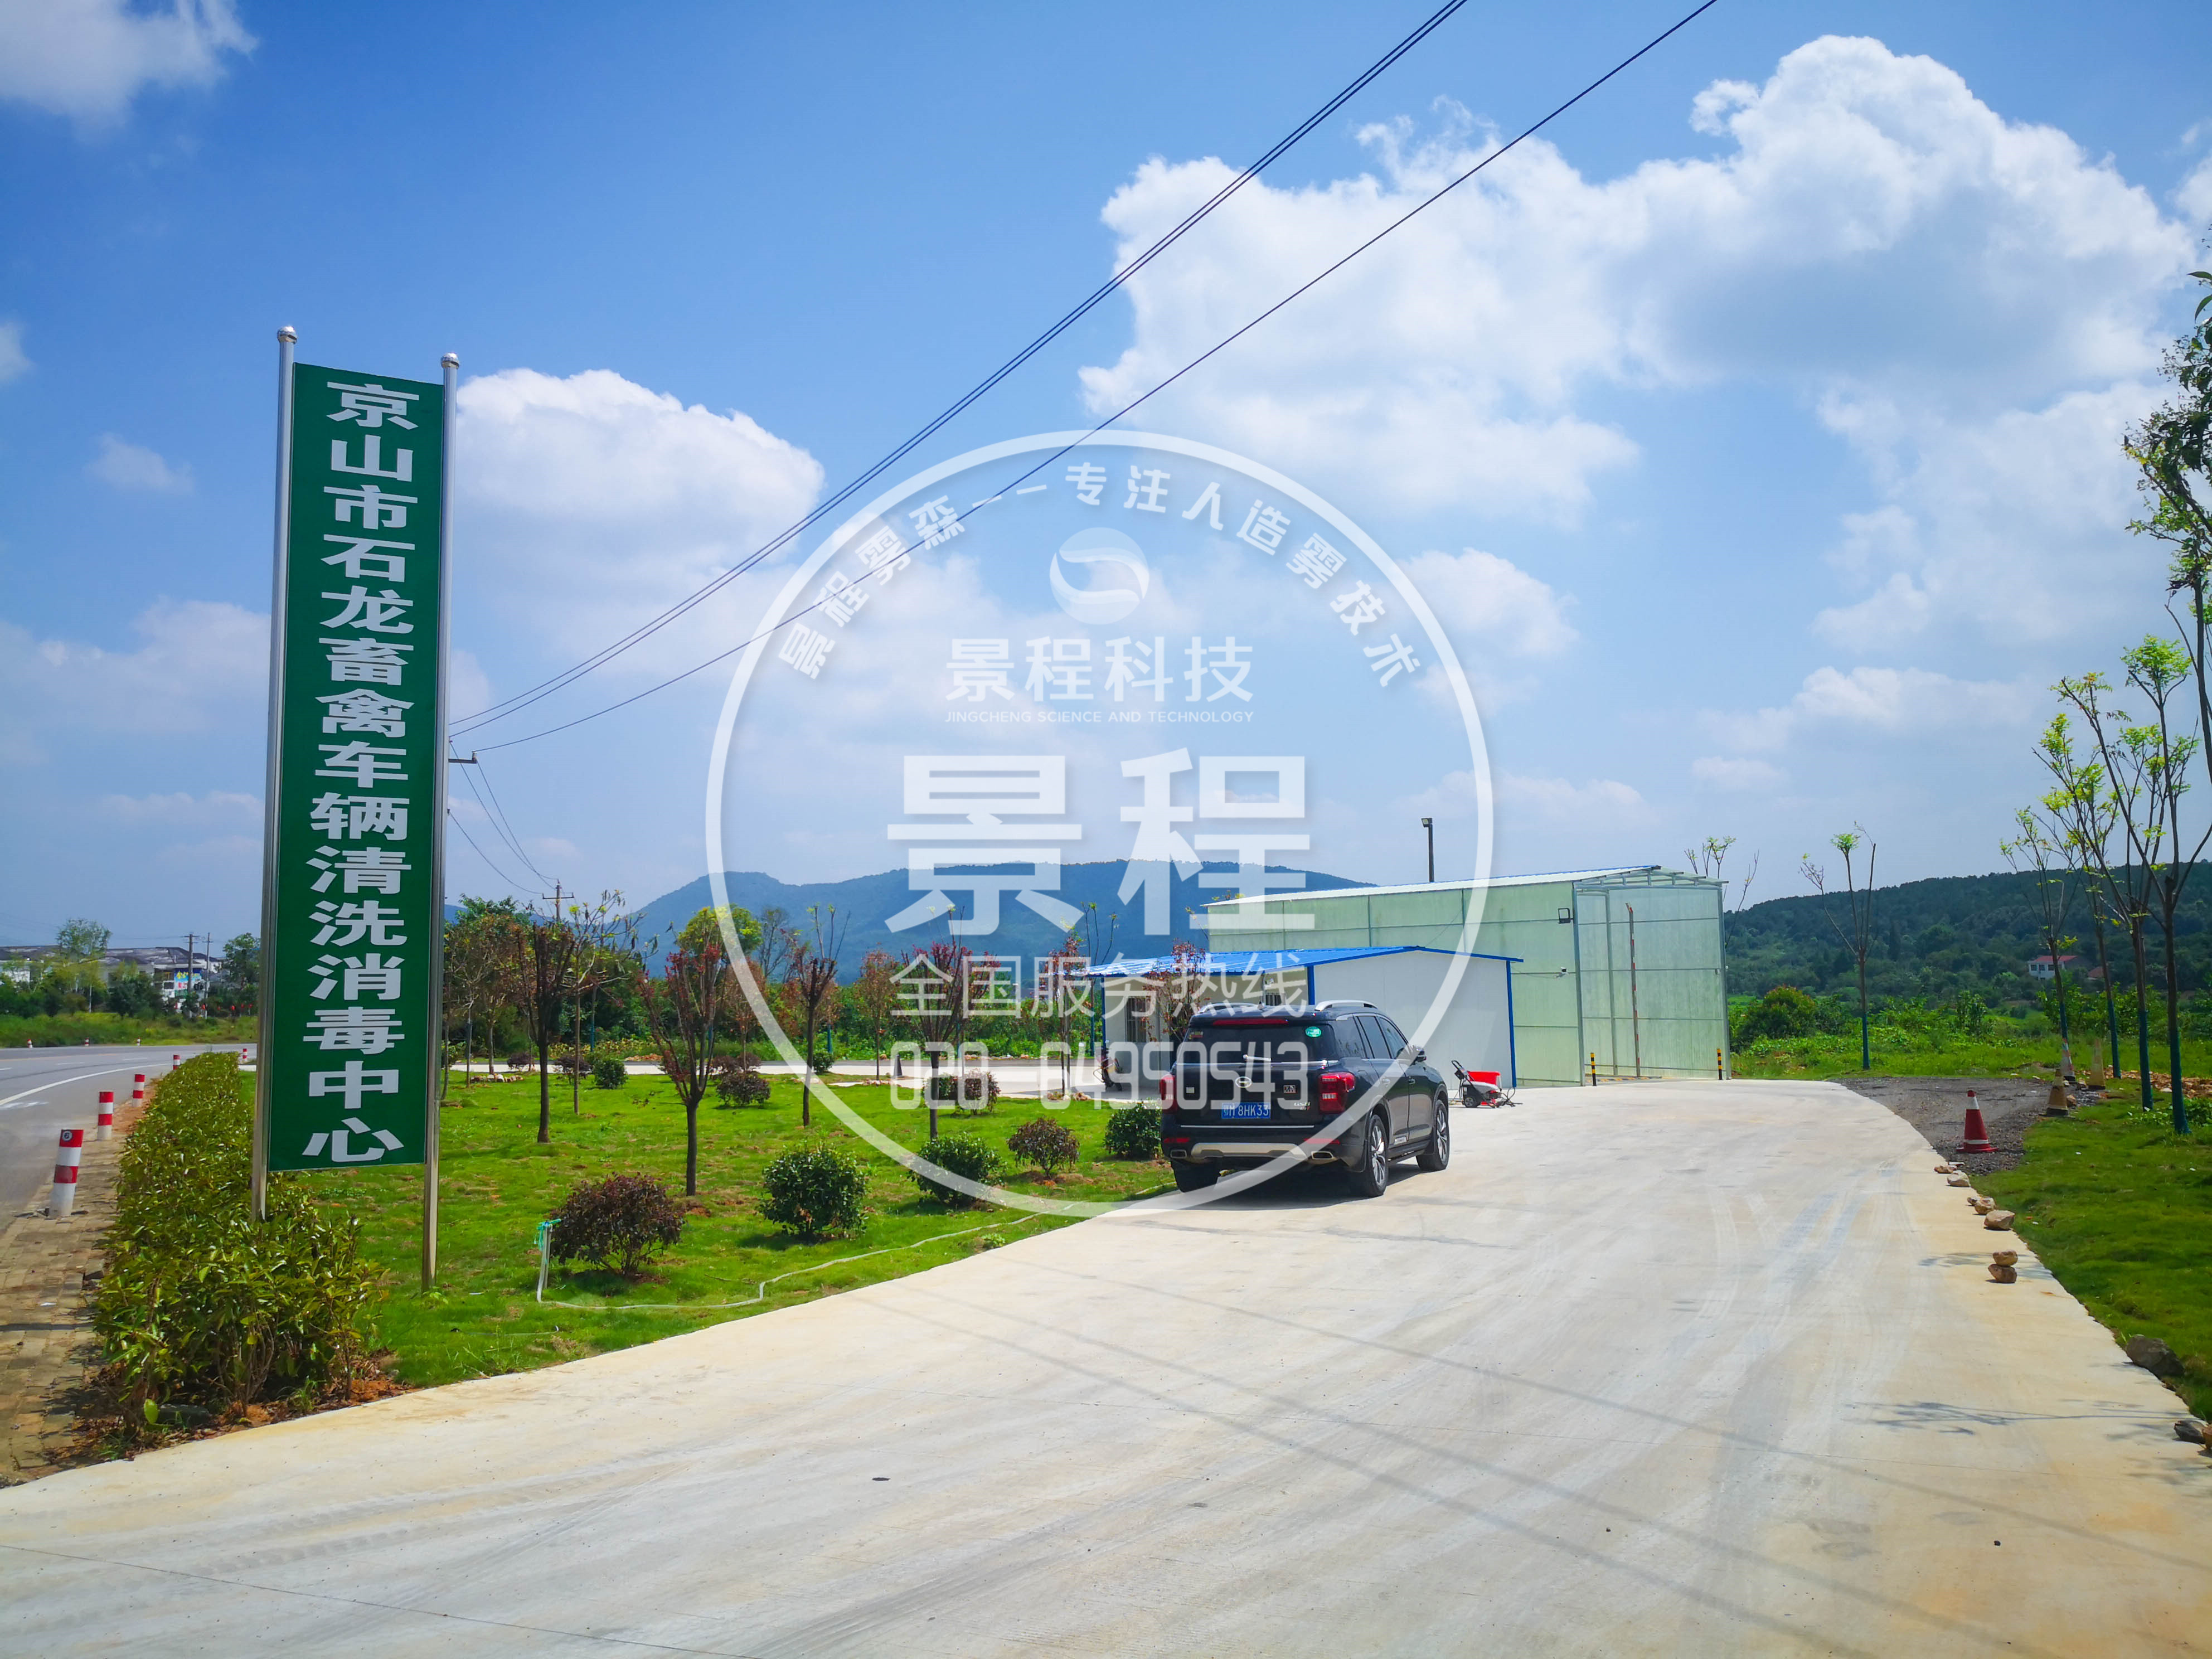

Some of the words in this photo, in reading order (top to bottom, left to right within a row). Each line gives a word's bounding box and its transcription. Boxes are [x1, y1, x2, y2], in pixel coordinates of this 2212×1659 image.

[302, 381, 419, 1163] 京山市石龙畜禽车辆清洗消毒中心
